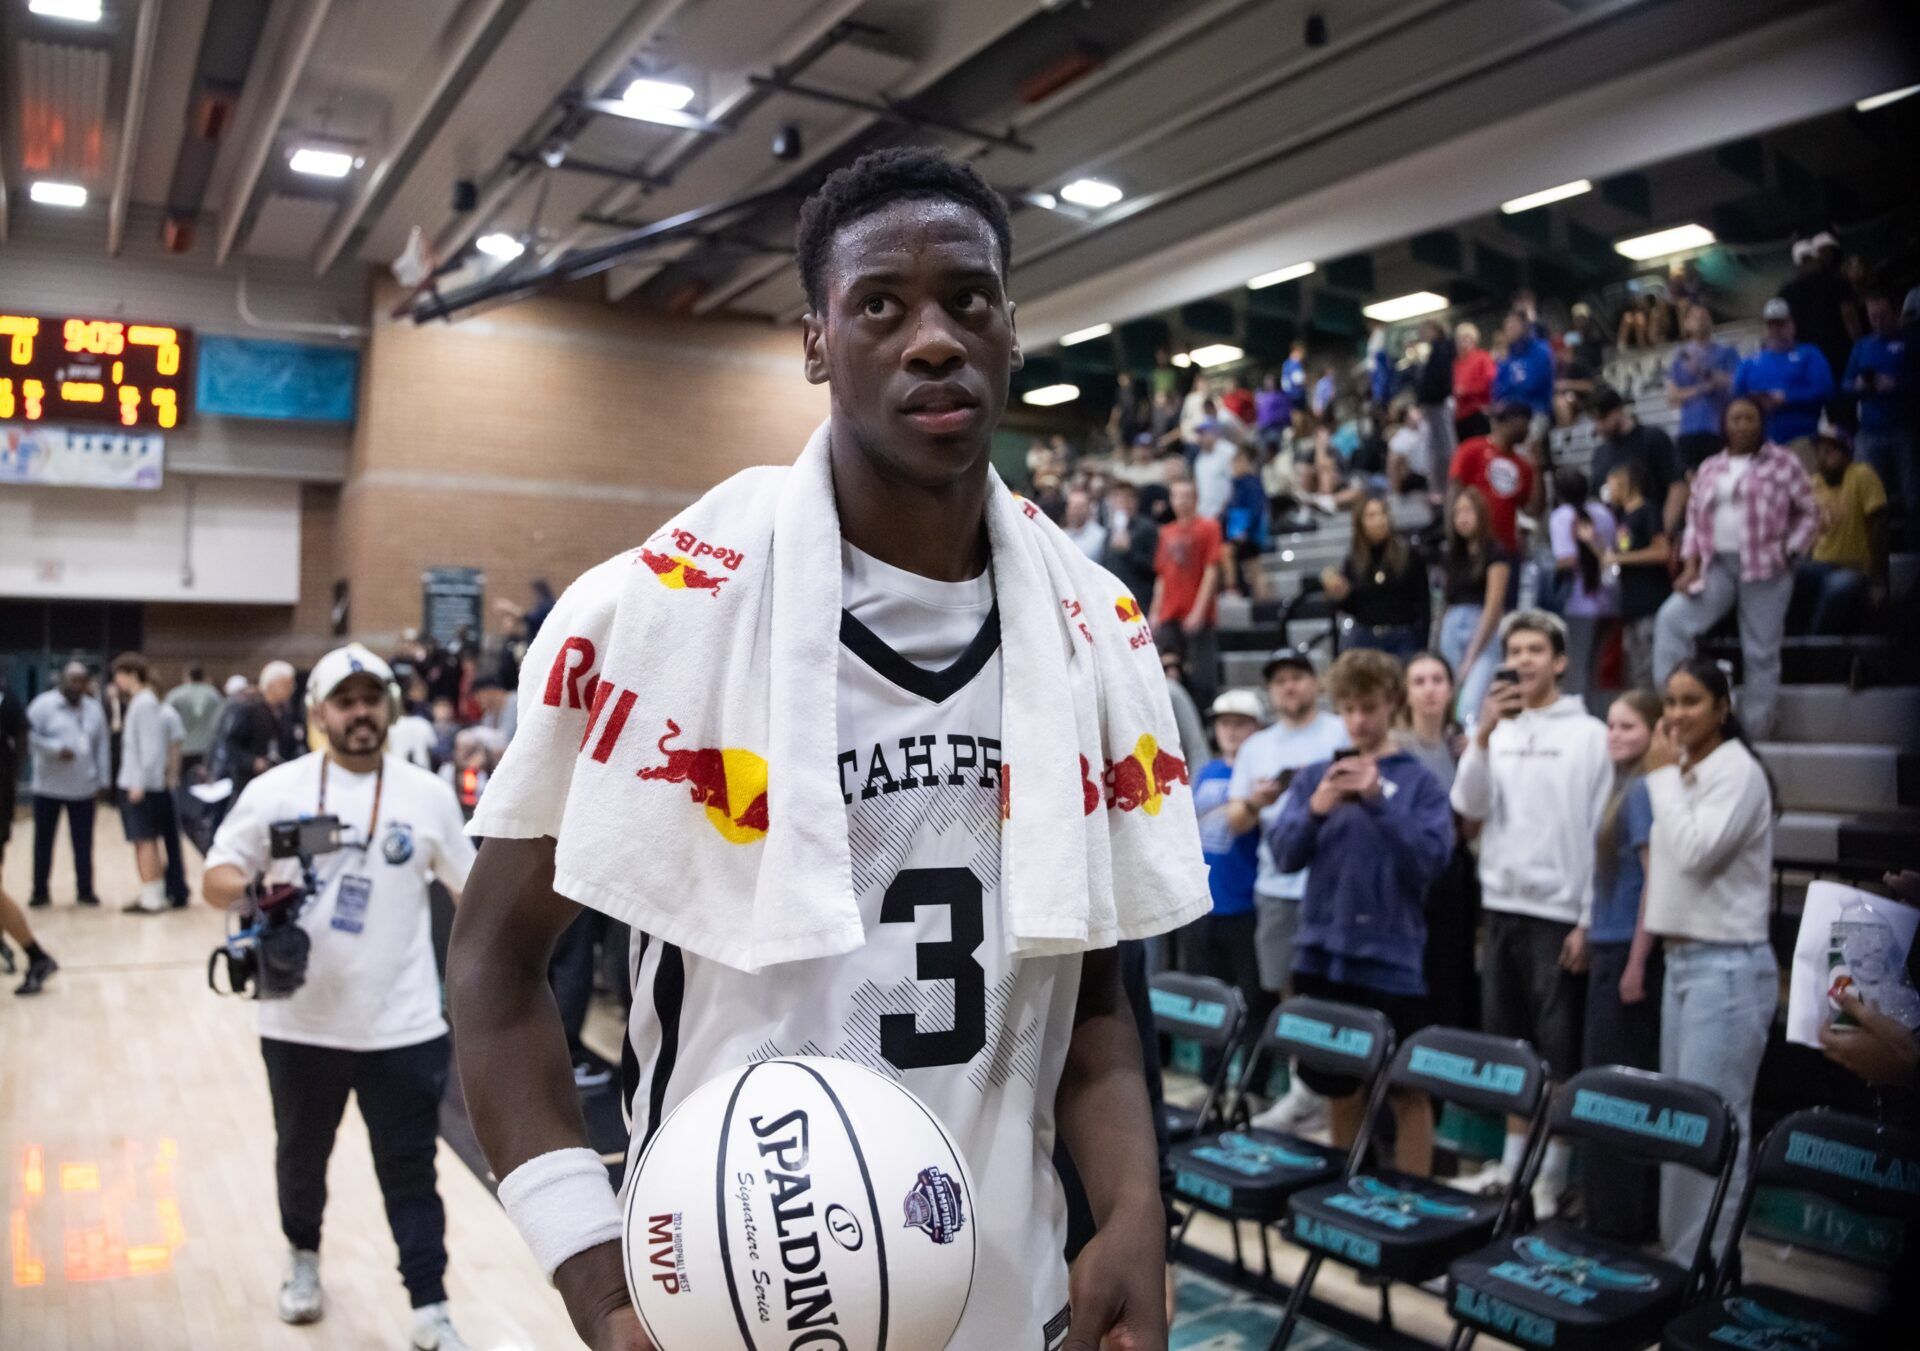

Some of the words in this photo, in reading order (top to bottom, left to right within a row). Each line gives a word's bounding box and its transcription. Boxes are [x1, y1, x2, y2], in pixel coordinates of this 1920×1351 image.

[671, 528, 697, 553] B
[692, 542, 744, 570] Red
[880, 867, 987, 1071] 3
[1571, 1088, 1709, 1148] HIGHLAND
[673, 1212, 683, 1231] 2024
[928, 1167, 953, 1243] CHAMPIONS
[648, 1213, 680, 1295] MVP
[674, 1232, 686, 1271] HOOPHALL
[737, 1172, 760, 1260] Signature
[752, 1269, 771, 1324] Series
[678, 1271, 691, 1293] WEST
